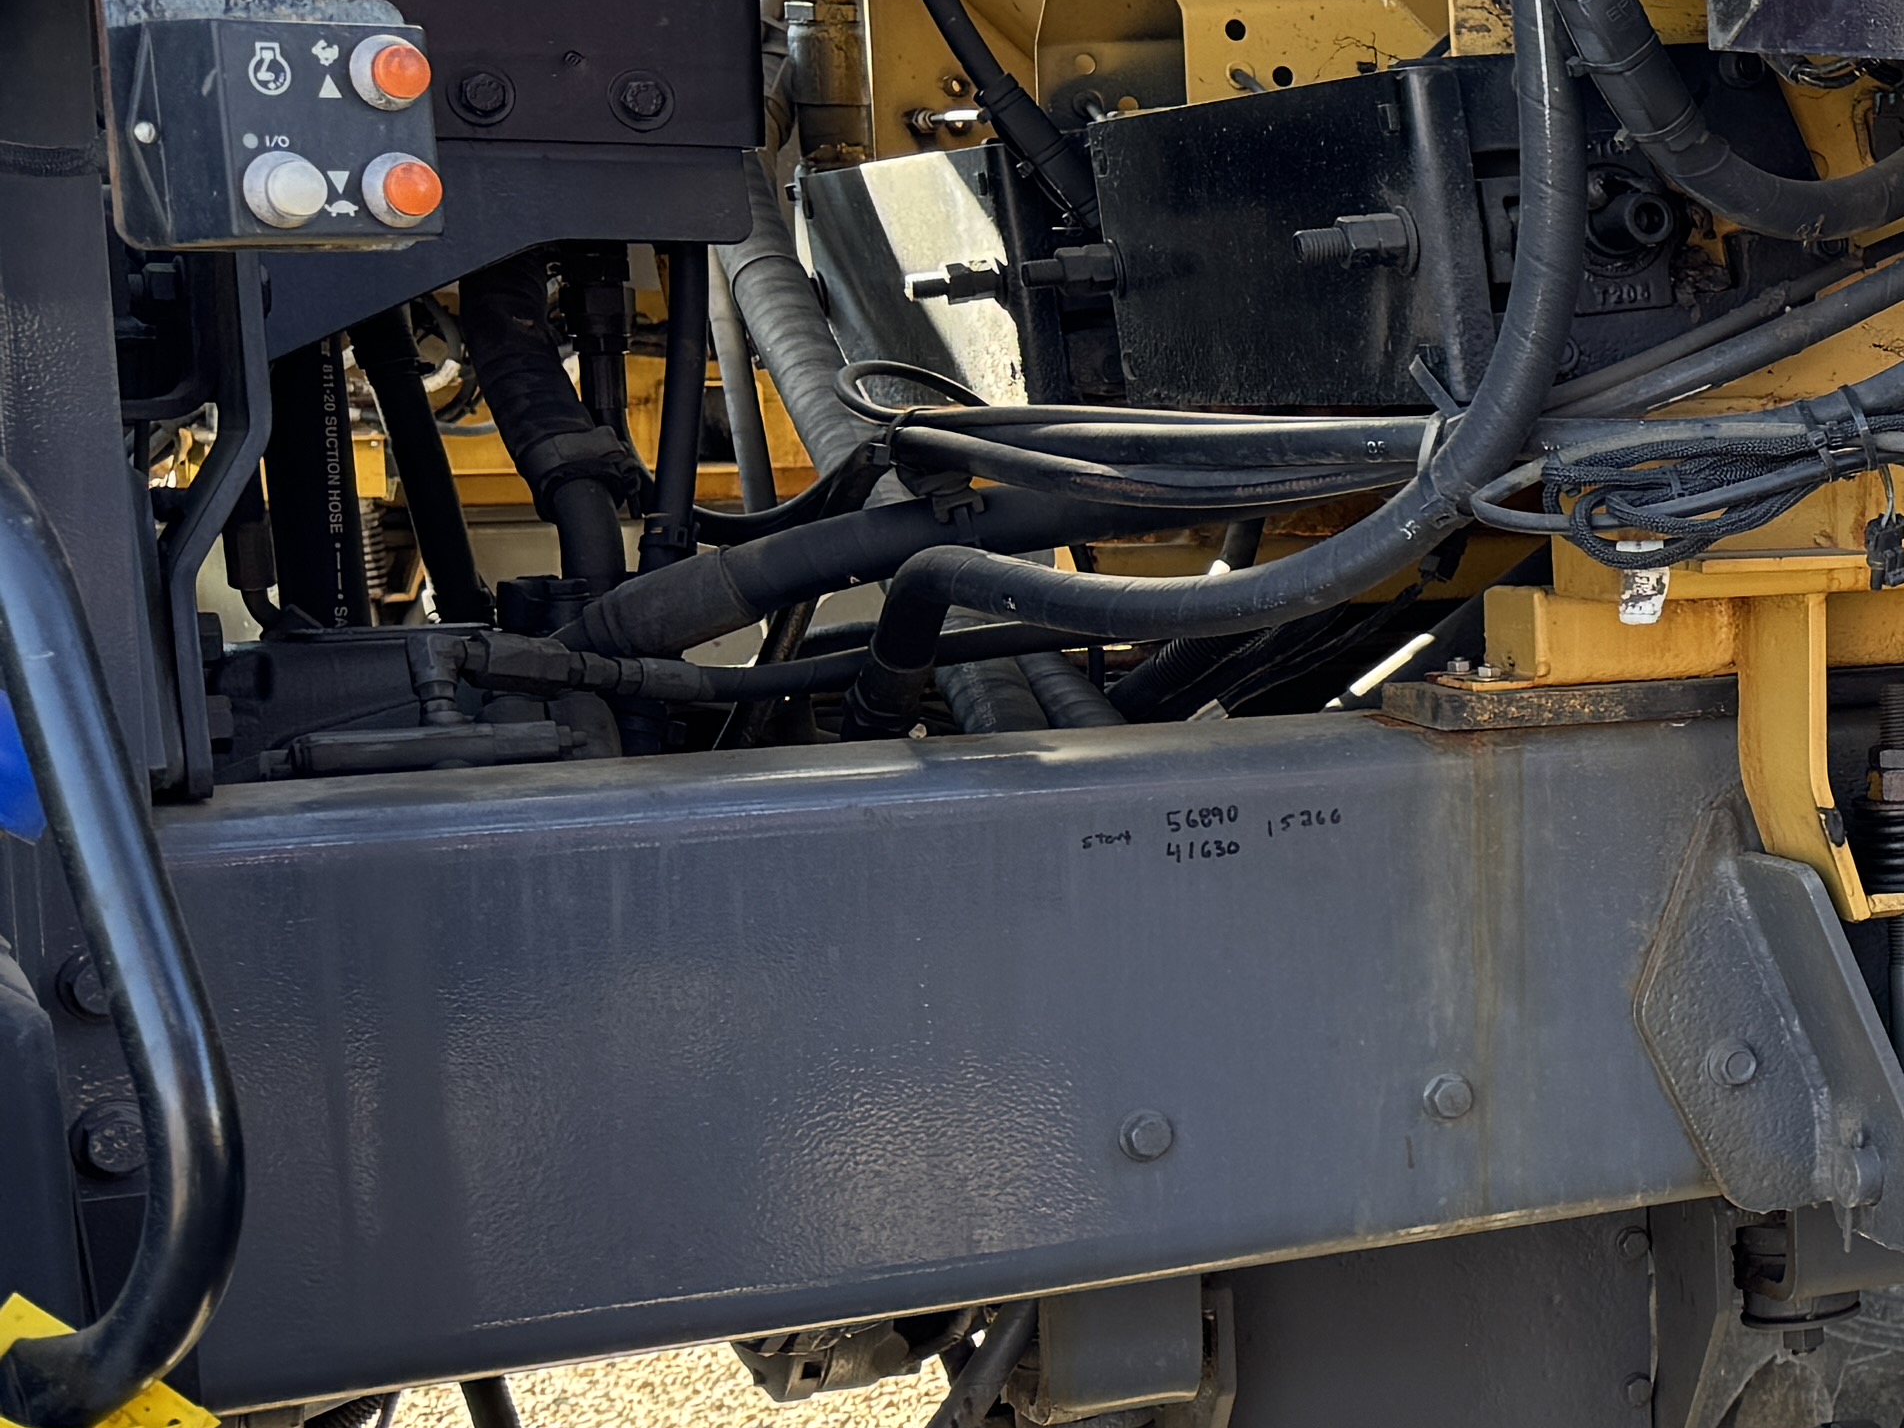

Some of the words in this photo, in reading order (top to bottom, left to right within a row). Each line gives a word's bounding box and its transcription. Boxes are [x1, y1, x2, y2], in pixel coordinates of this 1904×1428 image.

[322, 364, 335, 412] 811-20
[324, 416, 341, 486] SUCTION
[327, 489, 344, 535] HOSE
[1167, 804, 1239, 833] 56890
[1166, 839, 1240, 864] 41630
